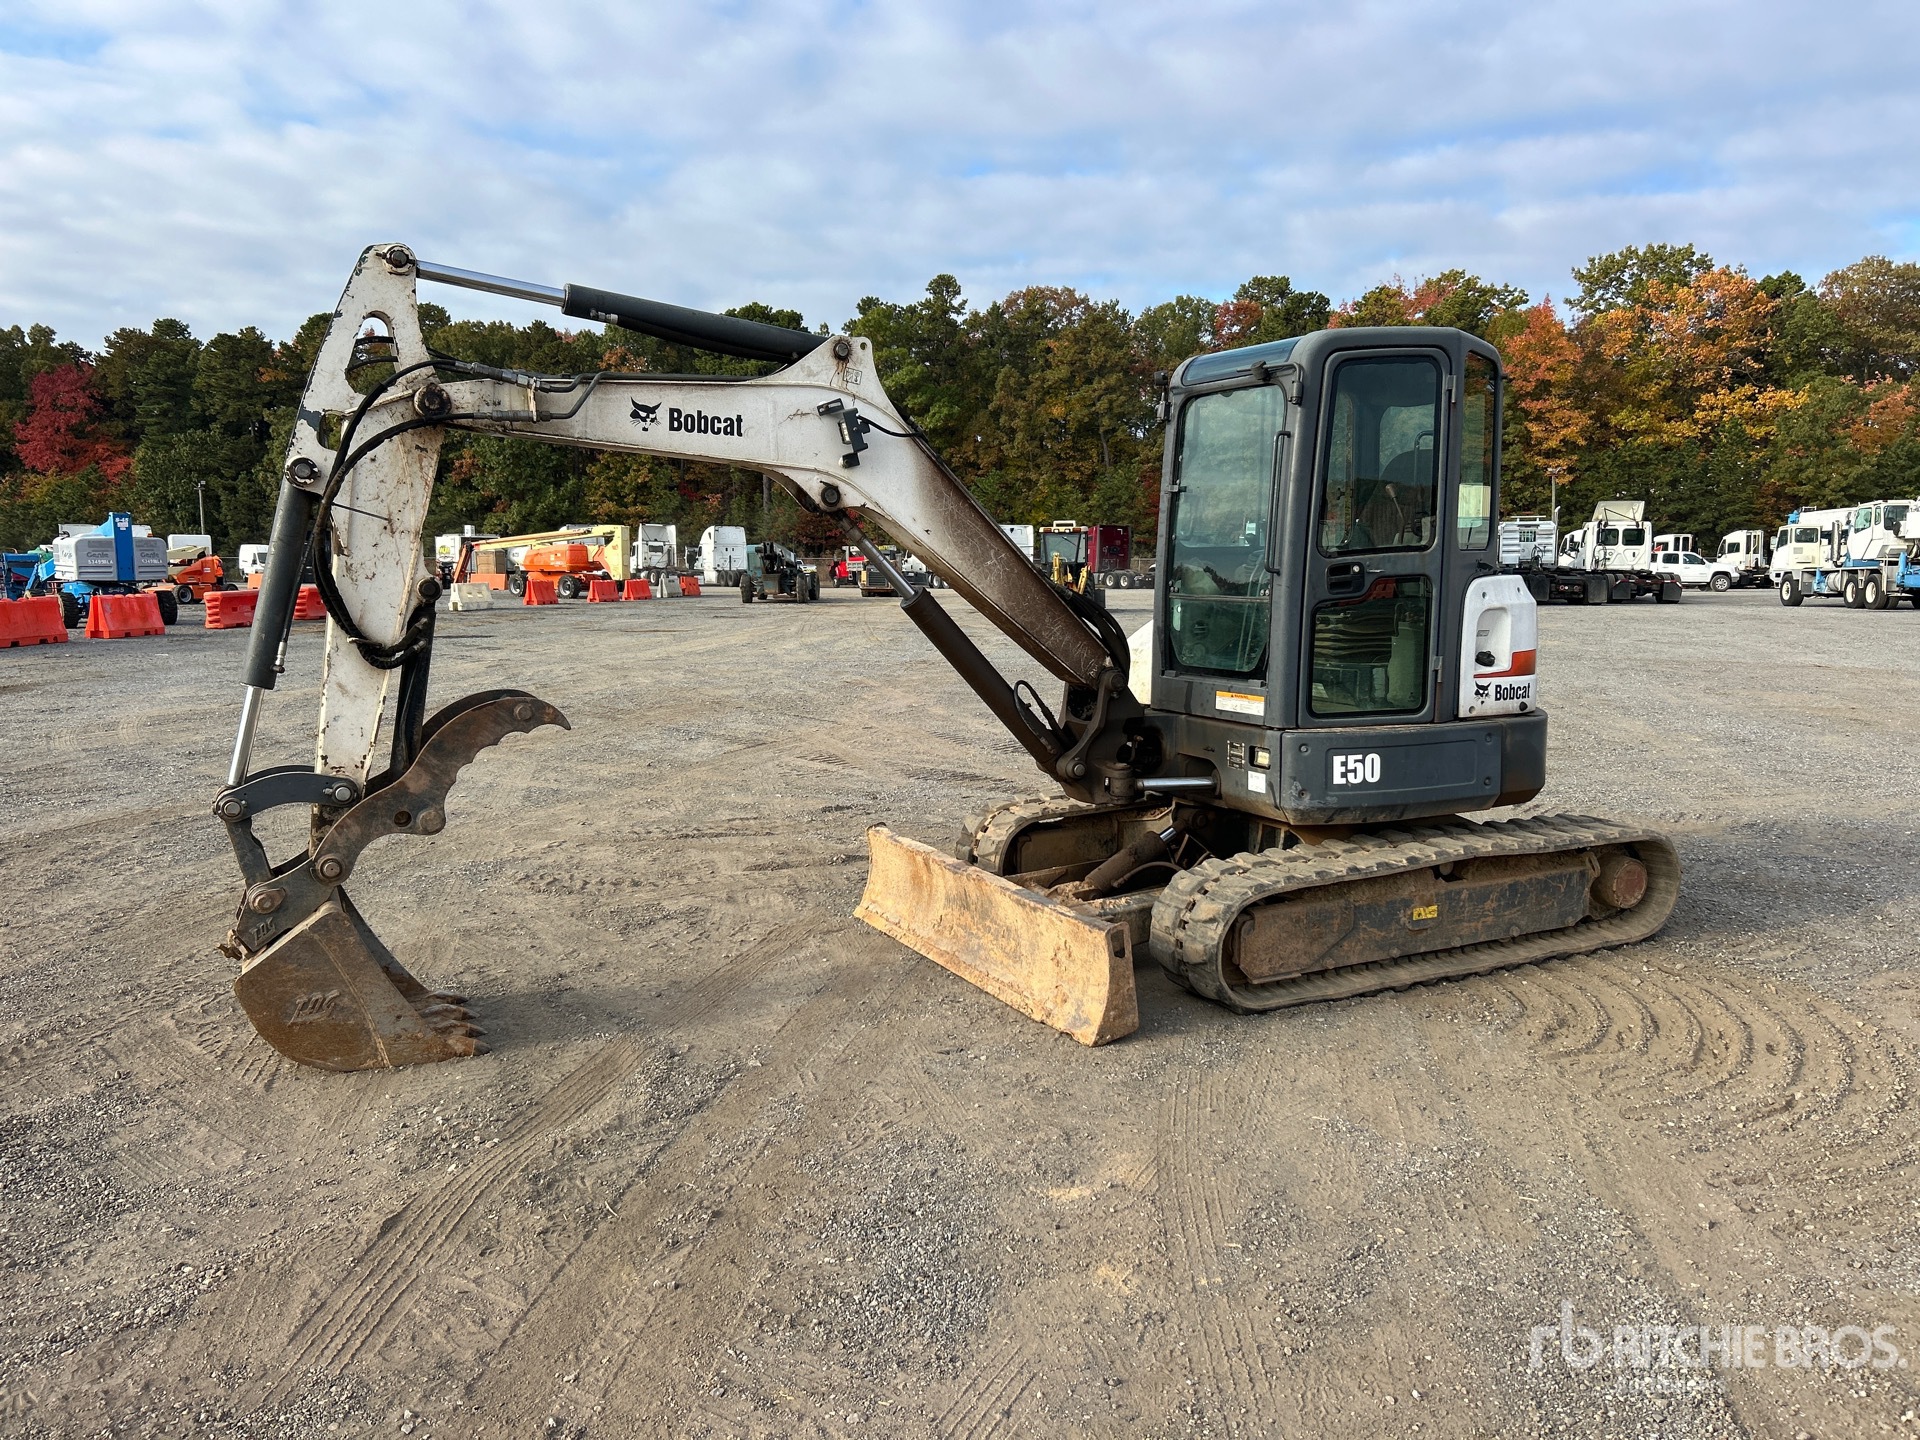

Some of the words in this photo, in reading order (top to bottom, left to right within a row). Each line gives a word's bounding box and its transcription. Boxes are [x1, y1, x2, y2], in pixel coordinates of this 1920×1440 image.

[669, 408, 743, 437] Bobcat
[1495, 683, 1531, 701] Bobcat
[1333, 753, 1381, 785] E50
